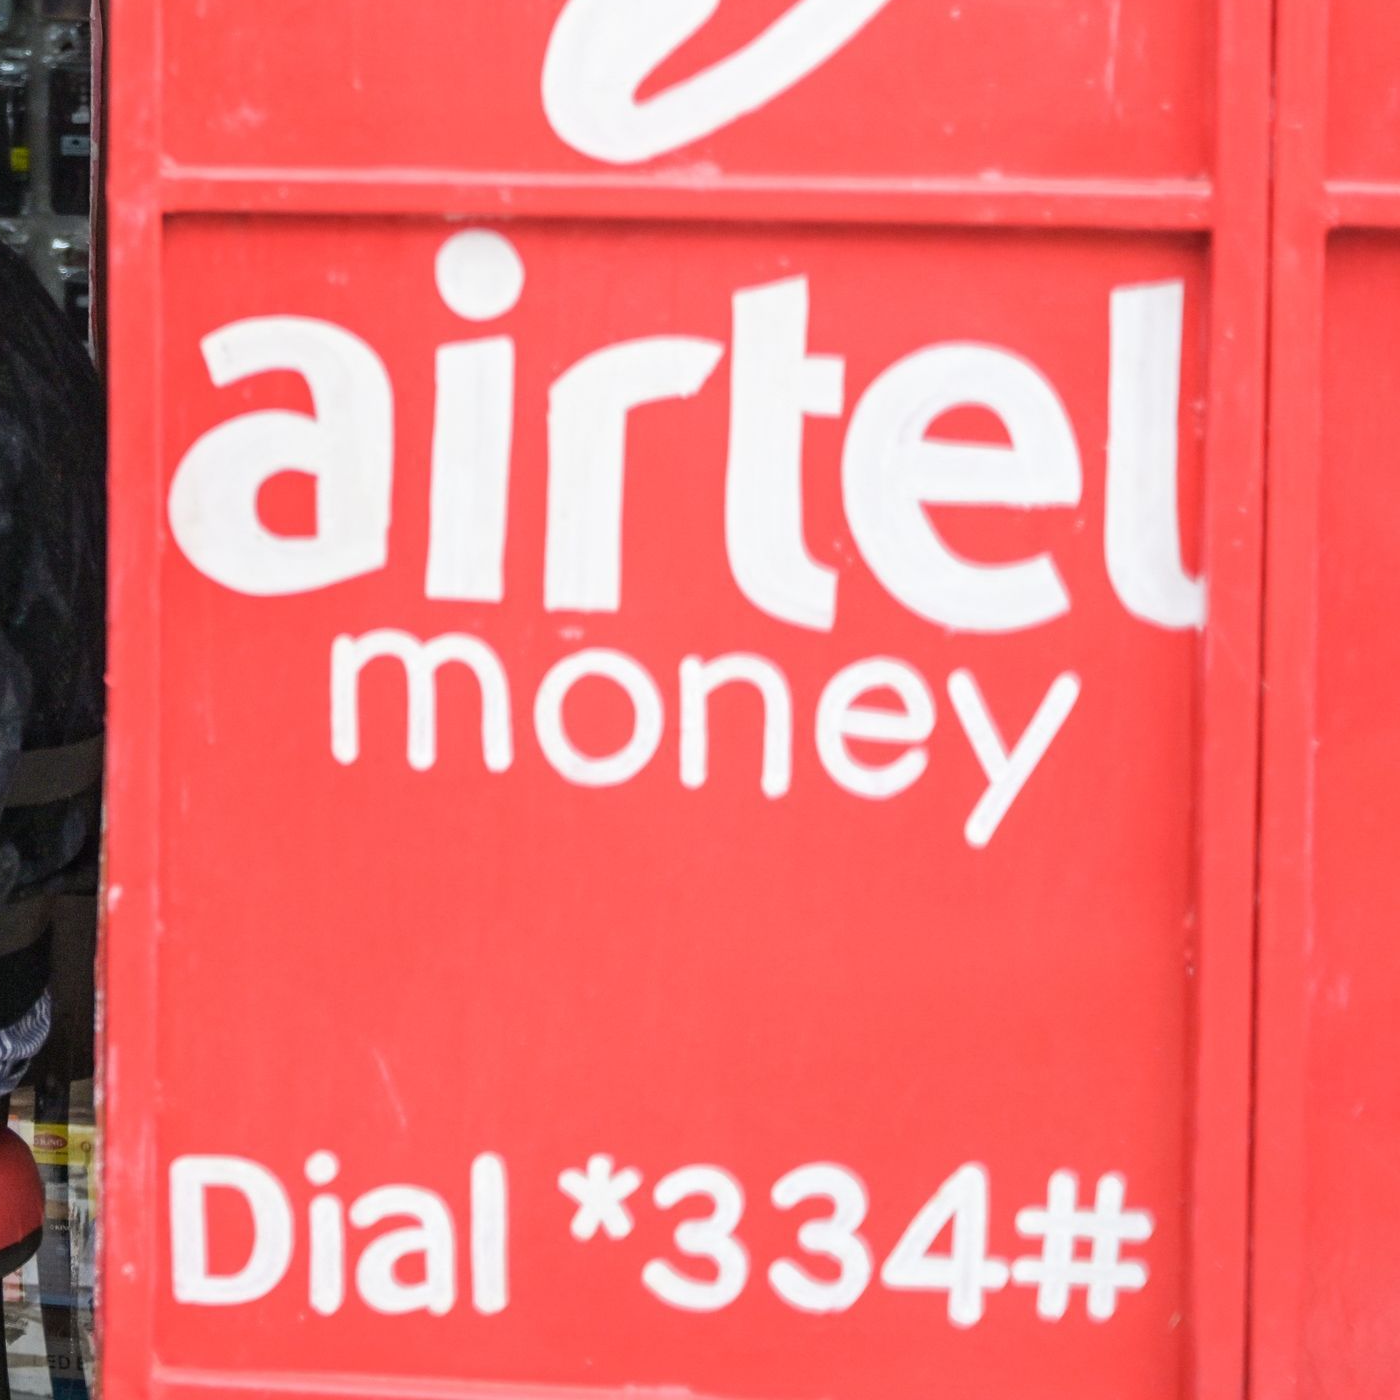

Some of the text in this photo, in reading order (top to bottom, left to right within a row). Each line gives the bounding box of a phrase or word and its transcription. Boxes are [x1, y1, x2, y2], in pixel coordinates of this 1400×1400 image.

[167, 228, 1208, 632] airtel
[331, 627, 1081, 847] money
[168, 1150, 510, 1317] Dial
